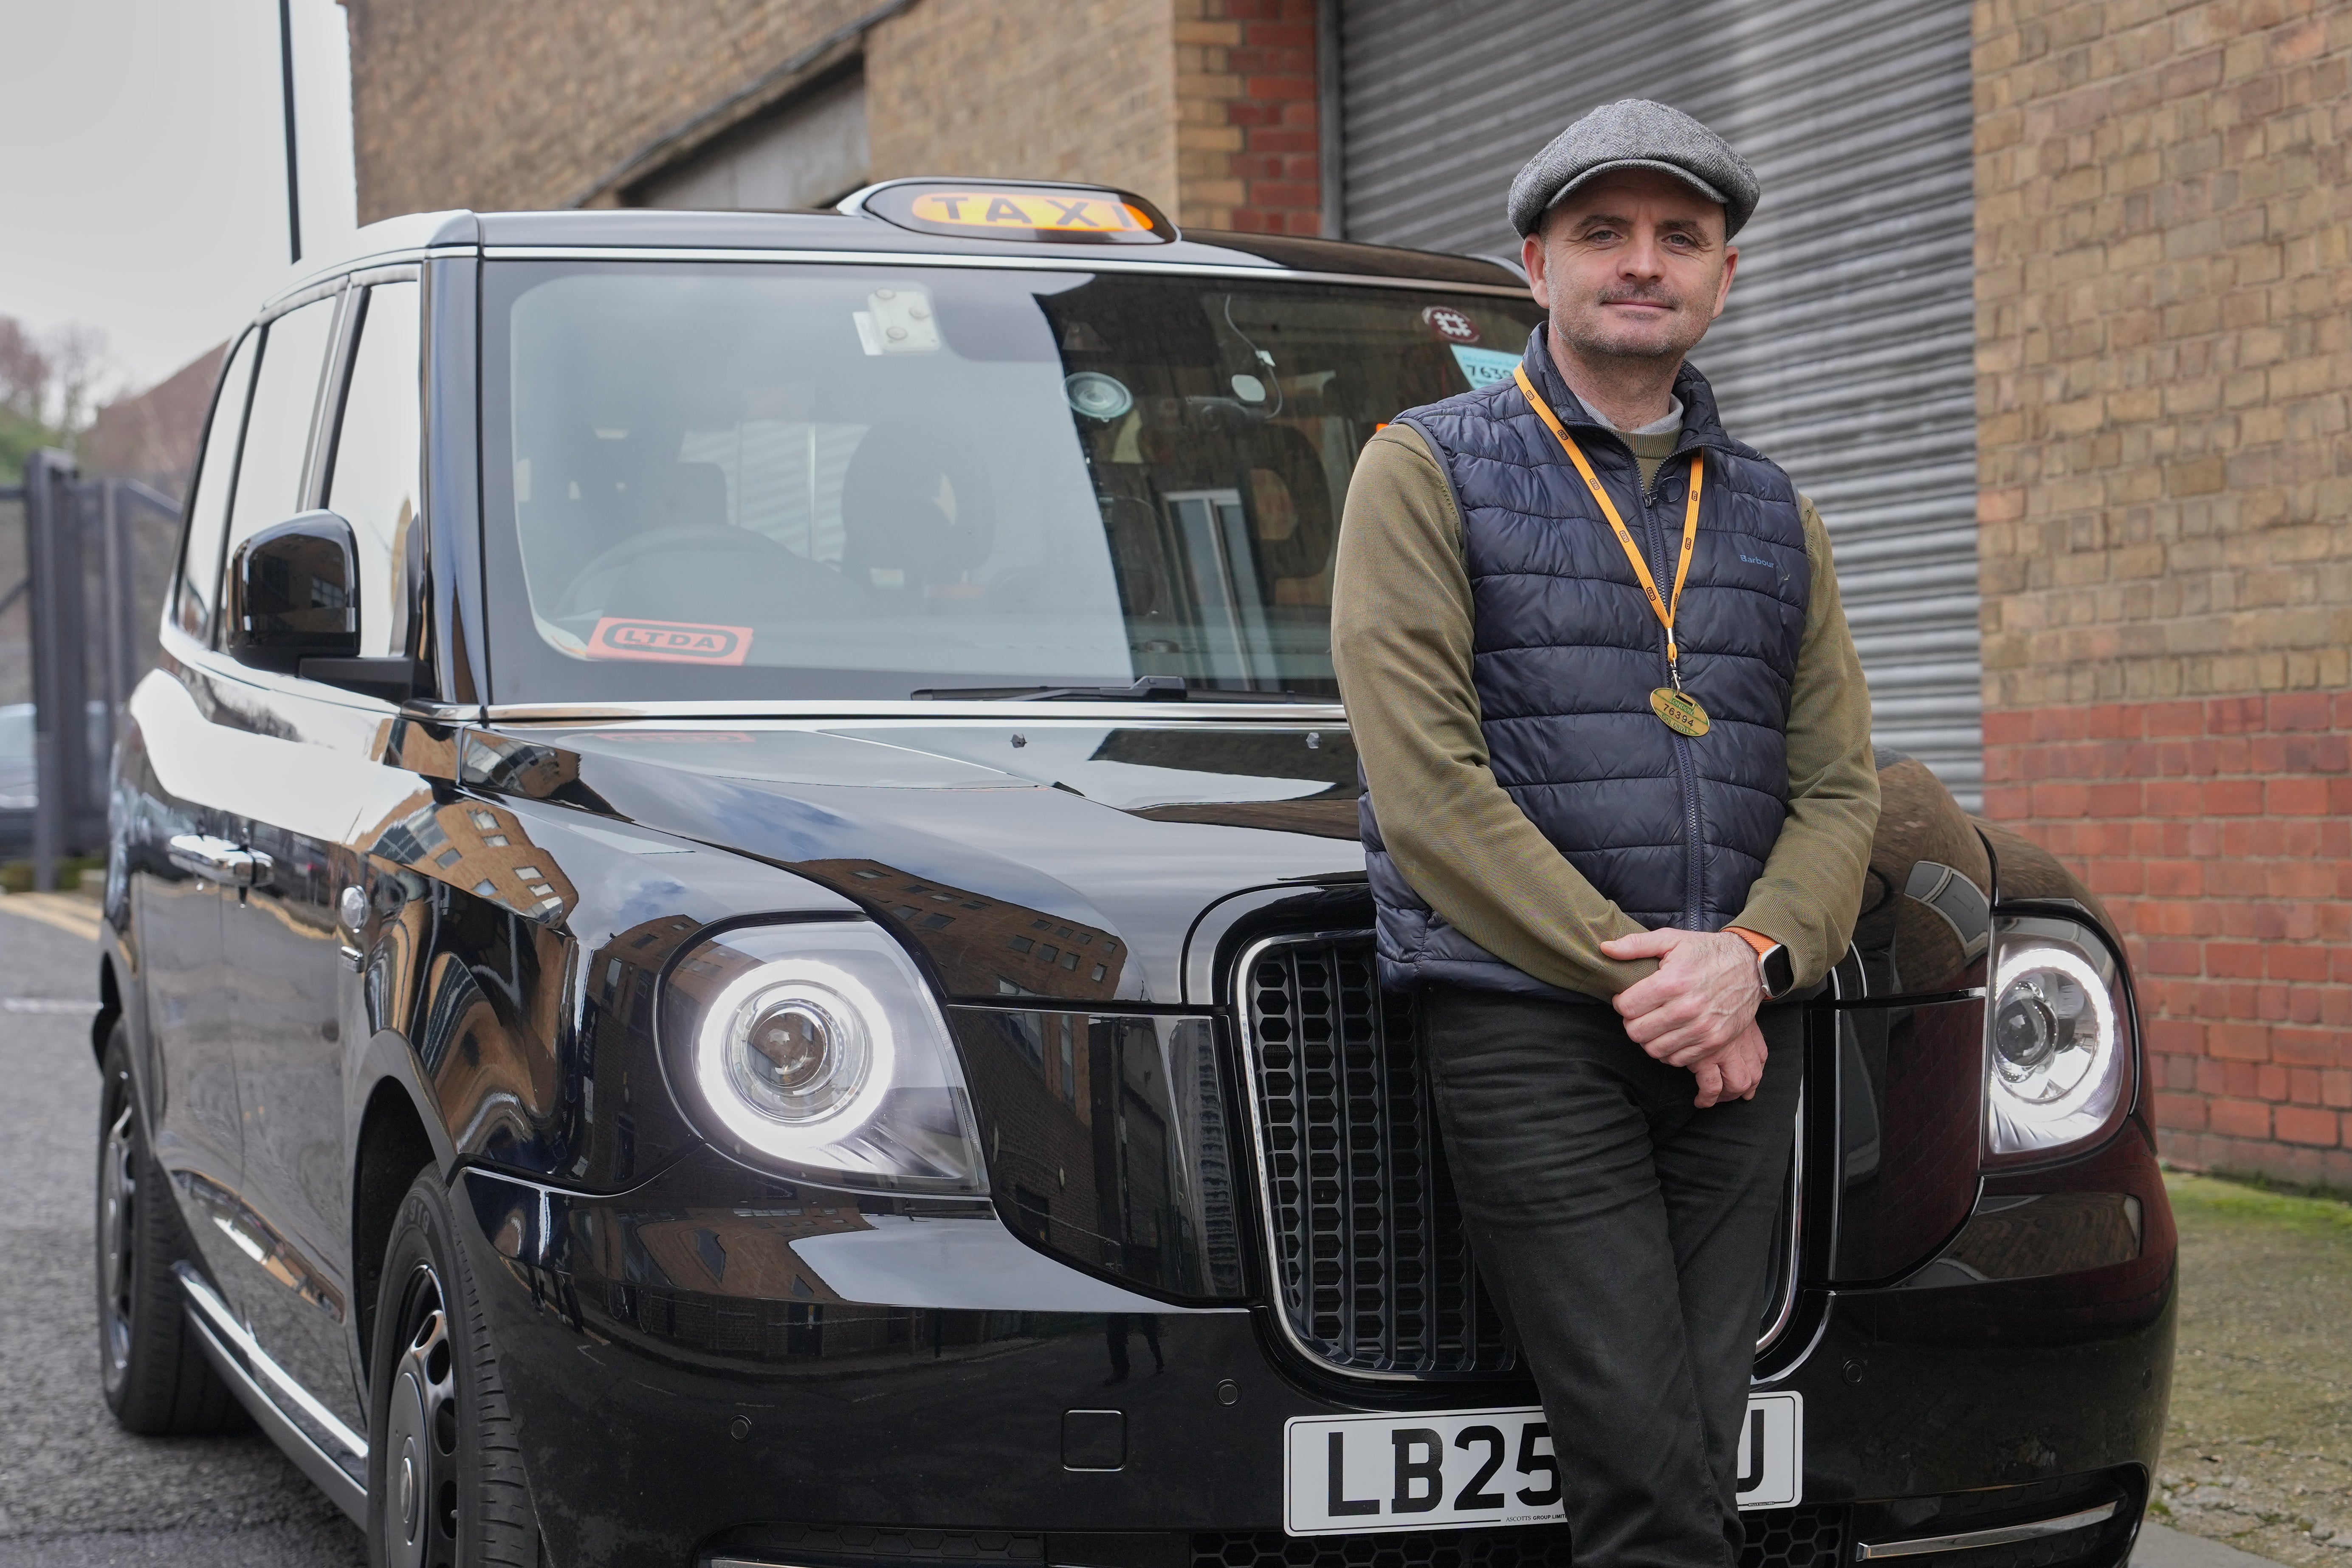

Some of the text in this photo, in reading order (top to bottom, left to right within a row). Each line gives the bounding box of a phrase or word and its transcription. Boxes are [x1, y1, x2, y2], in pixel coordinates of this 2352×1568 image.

[931, 197, 1133, 228] TAXI
[1740, 555, 1774, 568] Barbour
[624, 630, 715, 649] LTDA
[1663, 703, 1694, 727] 76394
[1670, 698, 1694, 716] LONDON
[1672, 722, 1690, 733] DRIVER
[1328, 1423, 1563, 1517] LB25
